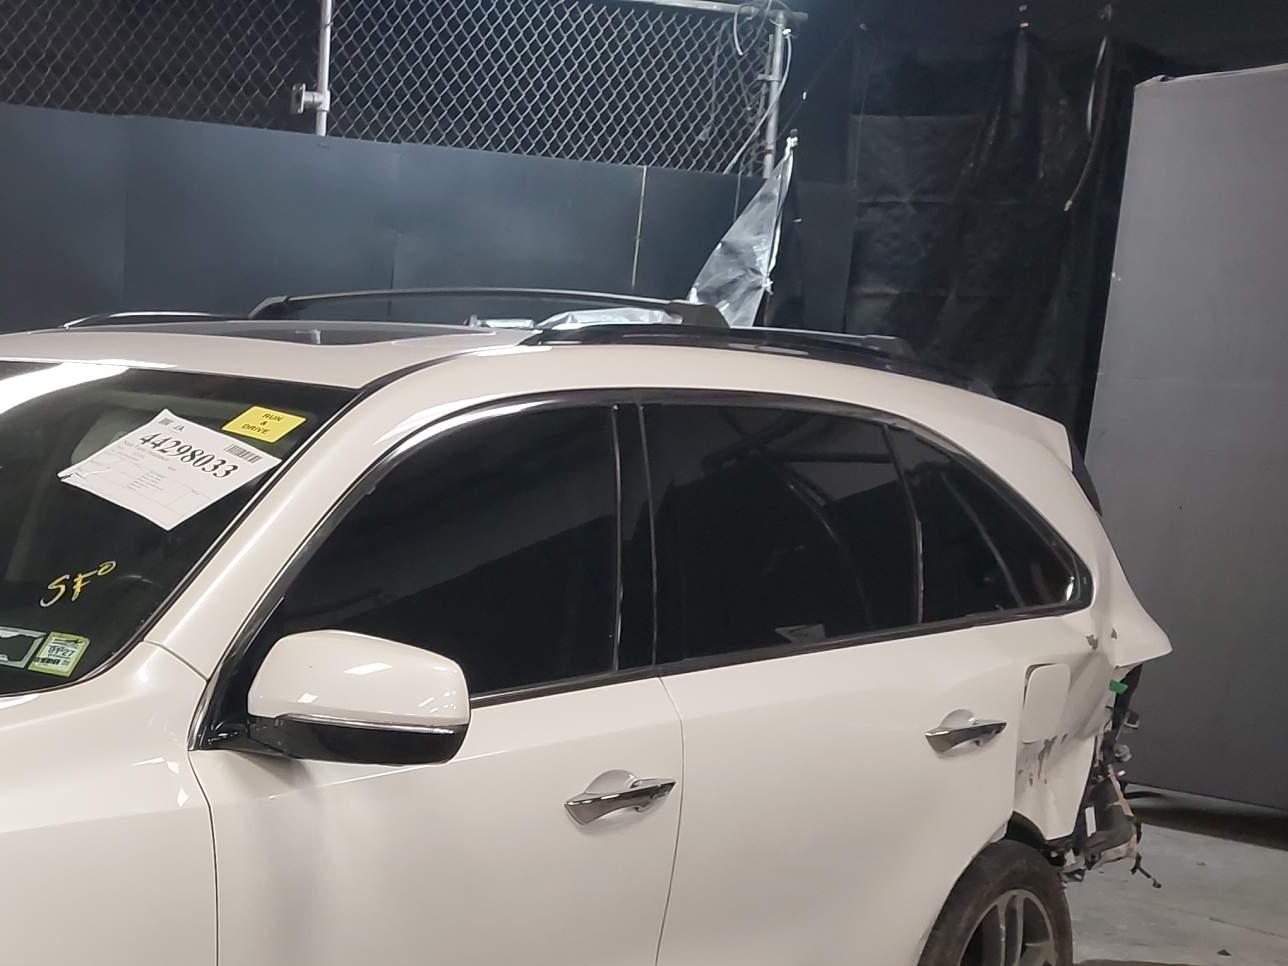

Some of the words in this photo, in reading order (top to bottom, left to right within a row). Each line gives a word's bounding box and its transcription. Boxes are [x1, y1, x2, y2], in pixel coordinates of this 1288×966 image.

[262, 413, 284, 422] RUN
[241, 424, 271, 434] DRIVE
[139, 432, 239, 478] 44298033
